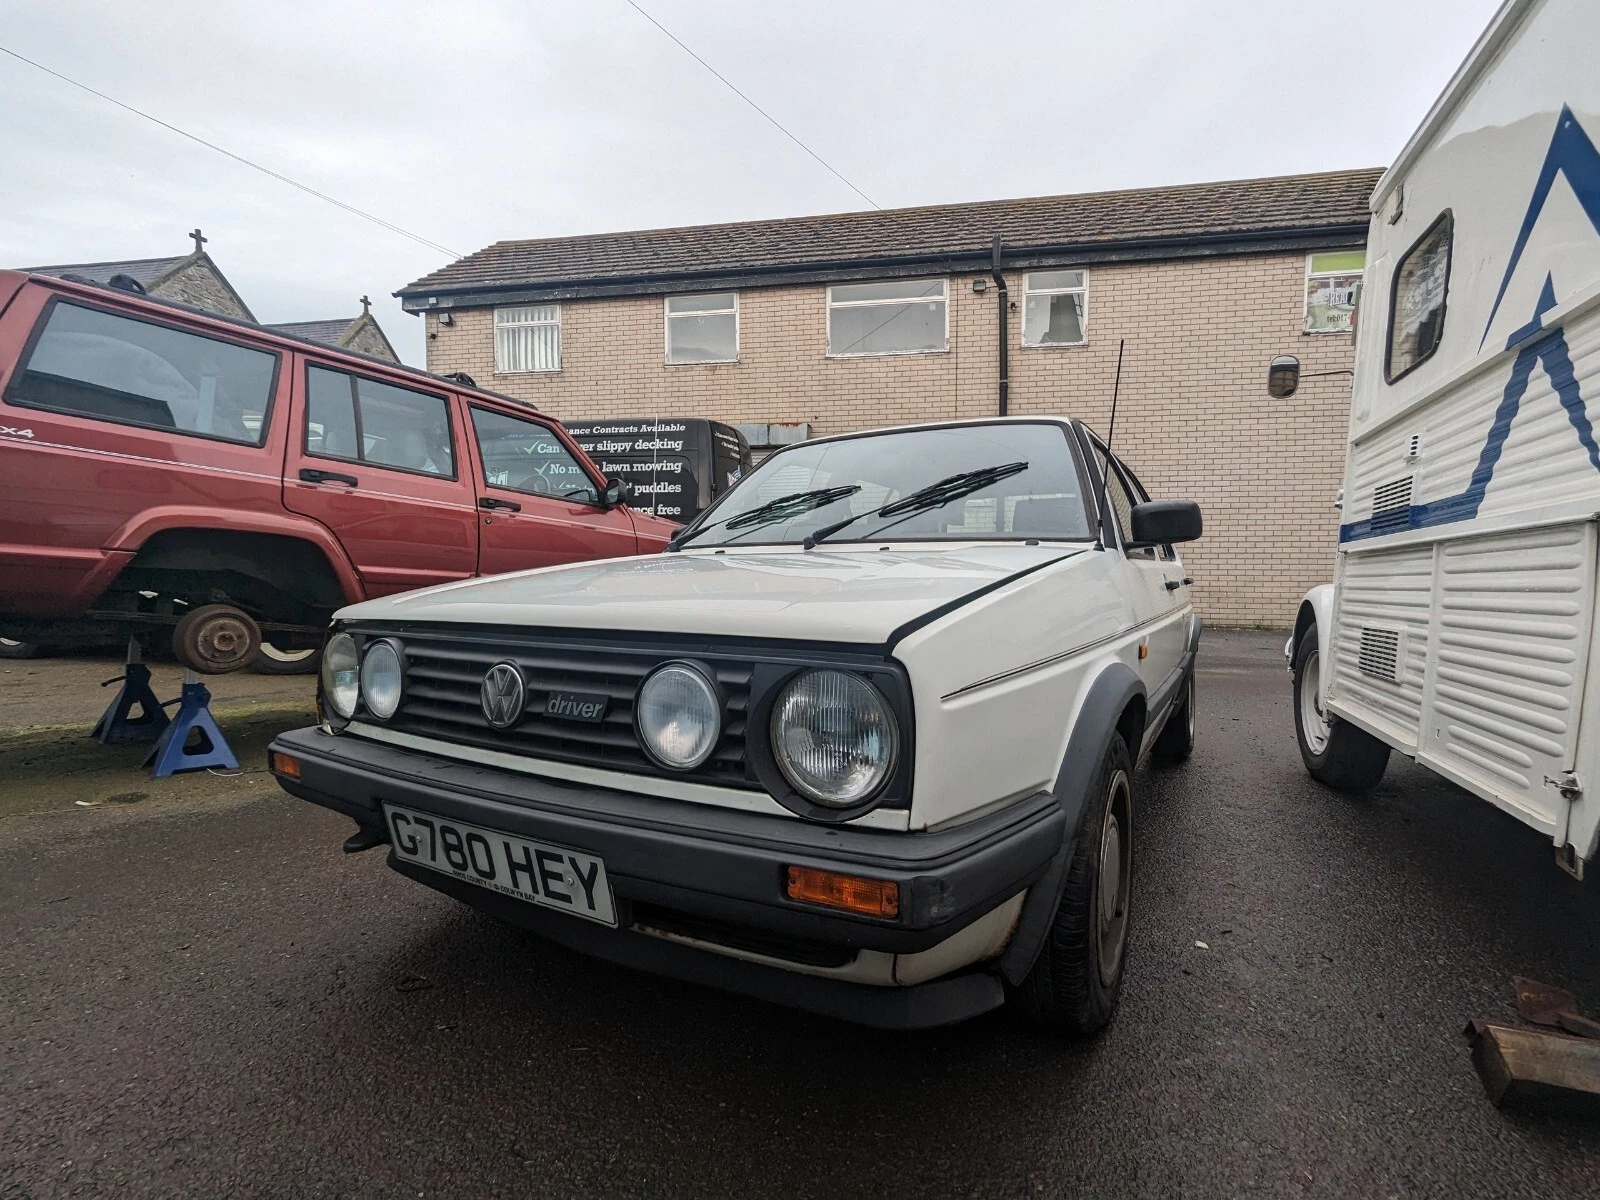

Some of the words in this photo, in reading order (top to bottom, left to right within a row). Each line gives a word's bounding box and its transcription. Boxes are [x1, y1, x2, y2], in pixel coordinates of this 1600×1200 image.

[593, 425, 638, 434] Contracts
[640, 423, 686, 433] Available
[537, 443, 560, 454] Can
[597, 440, 632, 453] slippy
[635, 438, 684, 451] decking
[550, 463, 566, 474] No
[602, 461, 630, 472] lawn
[633, 459, 682, 473] mowing
[634, 481, 682, 496] puddles
[657, 503, 680, 515] free
[547, 694, 604, 718] driver
[390, 811, 496, 881] G780
[503, 841, 598, 911] HEY
